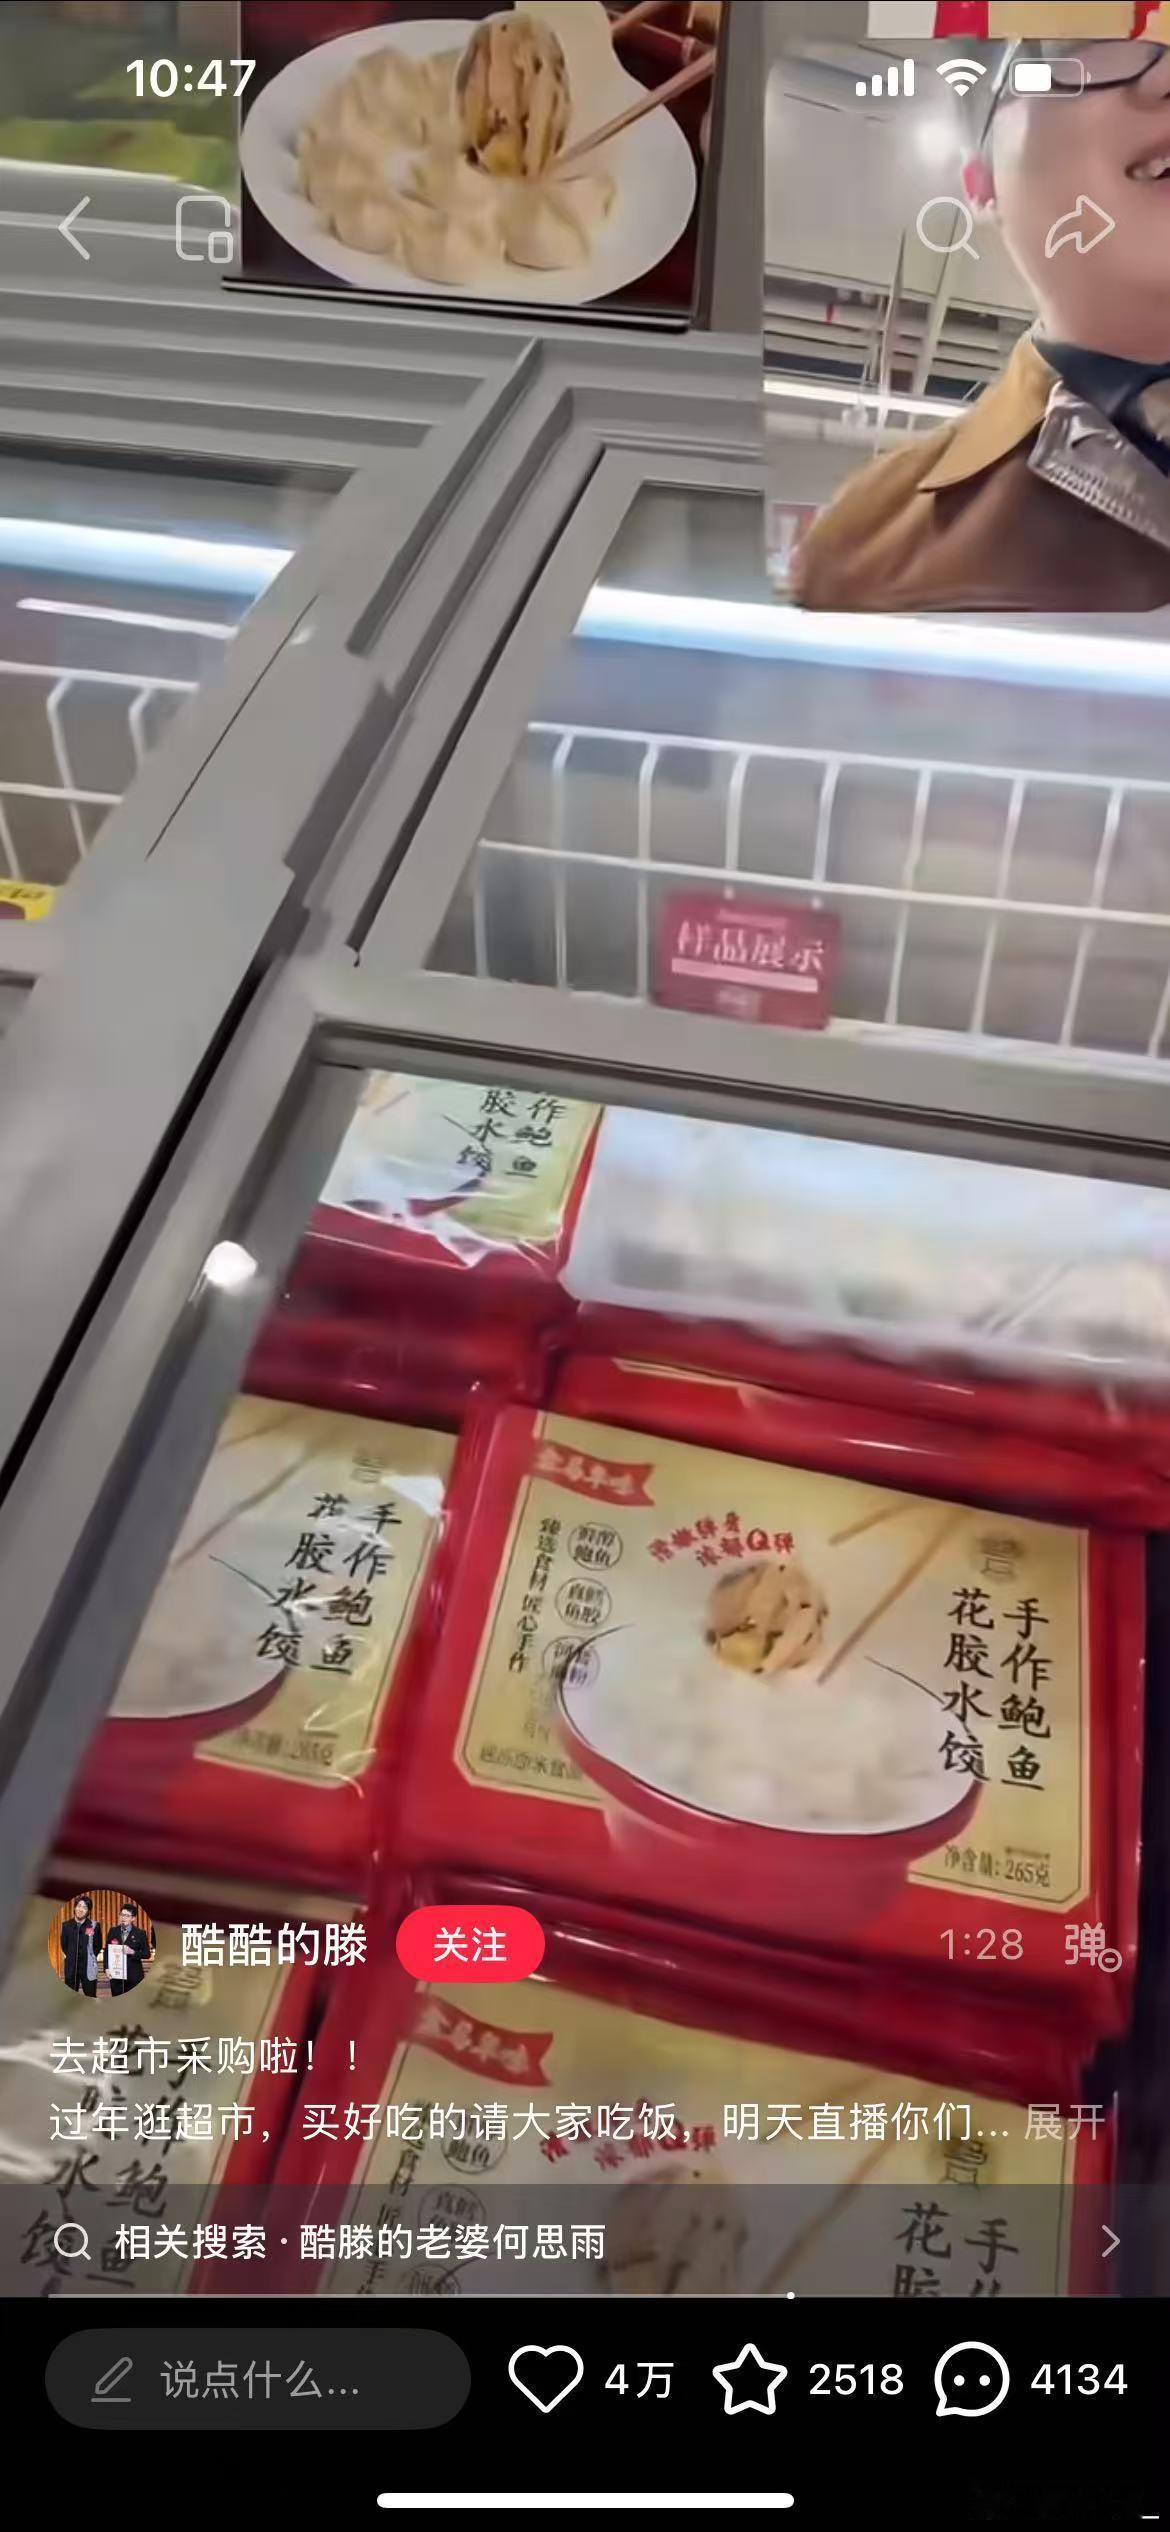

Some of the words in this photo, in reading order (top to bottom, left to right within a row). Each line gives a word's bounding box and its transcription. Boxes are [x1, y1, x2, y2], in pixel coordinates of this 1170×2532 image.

[677, 920, 825, 973] 样品展示
[255, 1489, 352, 1669] 花胶水饺
[320, 1501, 403, 1676] 手作鲍鱼
[938, 1586, 995, 1783] 花胶水饺
[998, 1597, 1055, 1793] 手作鲍鱼
